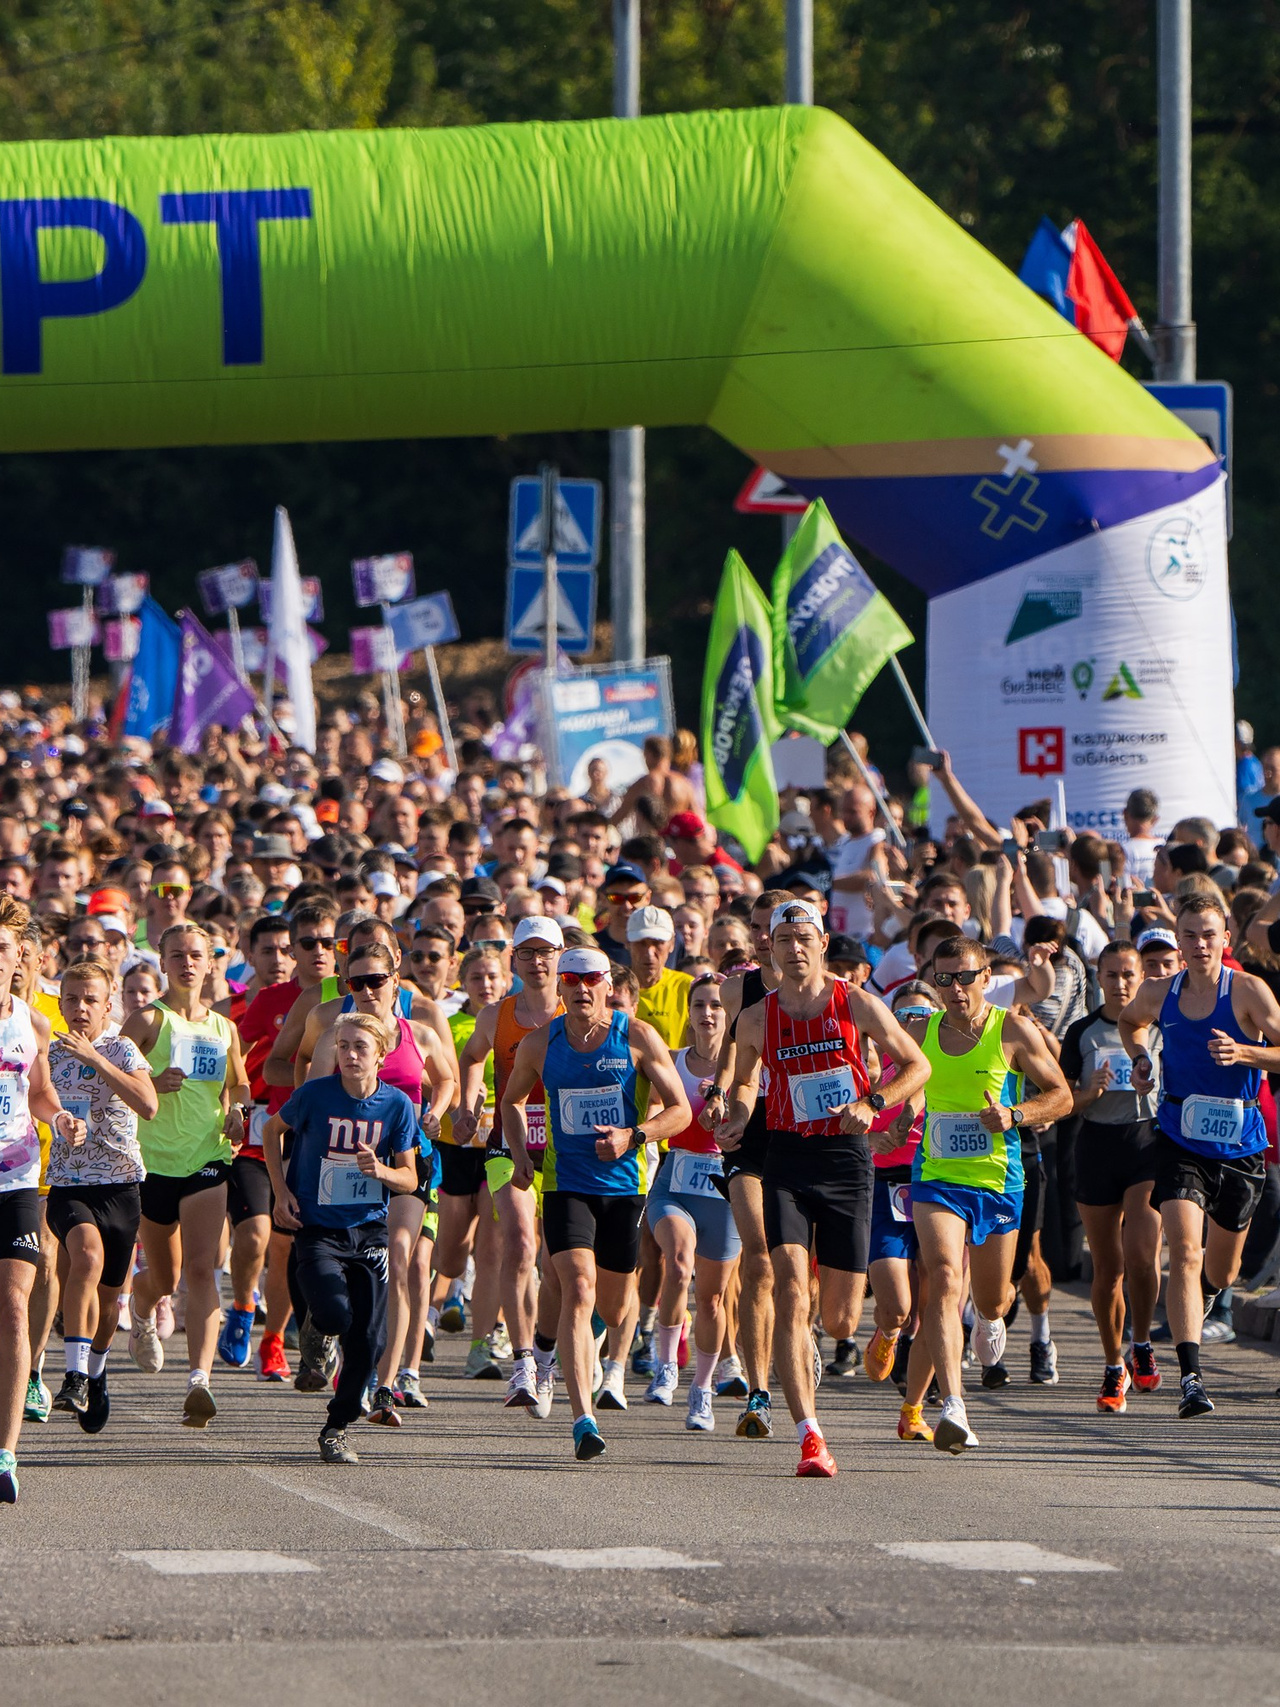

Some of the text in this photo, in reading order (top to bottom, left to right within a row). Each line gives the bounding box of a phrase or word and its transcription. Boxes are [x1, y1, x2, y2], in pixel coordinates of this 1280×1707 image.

[1072, 750, 1147, 766] область
[191, 1045, 218, 1056] ВАЛЕРИЯ
[779, 1039, 843, 1059] PRO NINE
[192, 1056, 217, 1075] 153
[819, 1080, 841, 1092] ДЕНИС
[579, 1096, 617, 1109] АЛЕКСАНДР
[815, 1088, 851, 1112] 1372
[527, 1115, 546, 1124] ЕРГЕЙ
[582, 1107, 620, 1128] 4180
[1208, 1108, 1233, 1118] ПЛАТОН
[955, 1123, 979, 1132] АНДРЕЙ
[1201, 1118, 1238, 1138] 3467
[950, 1133, 987, 1152] 3559
[693, 1161, 720, 1171] АНГЕЛИН
[689, 1171, 715, 1192] 470
[352, 1181, 368, 1199] 14
[12, 1241, 40, 1253] adida
